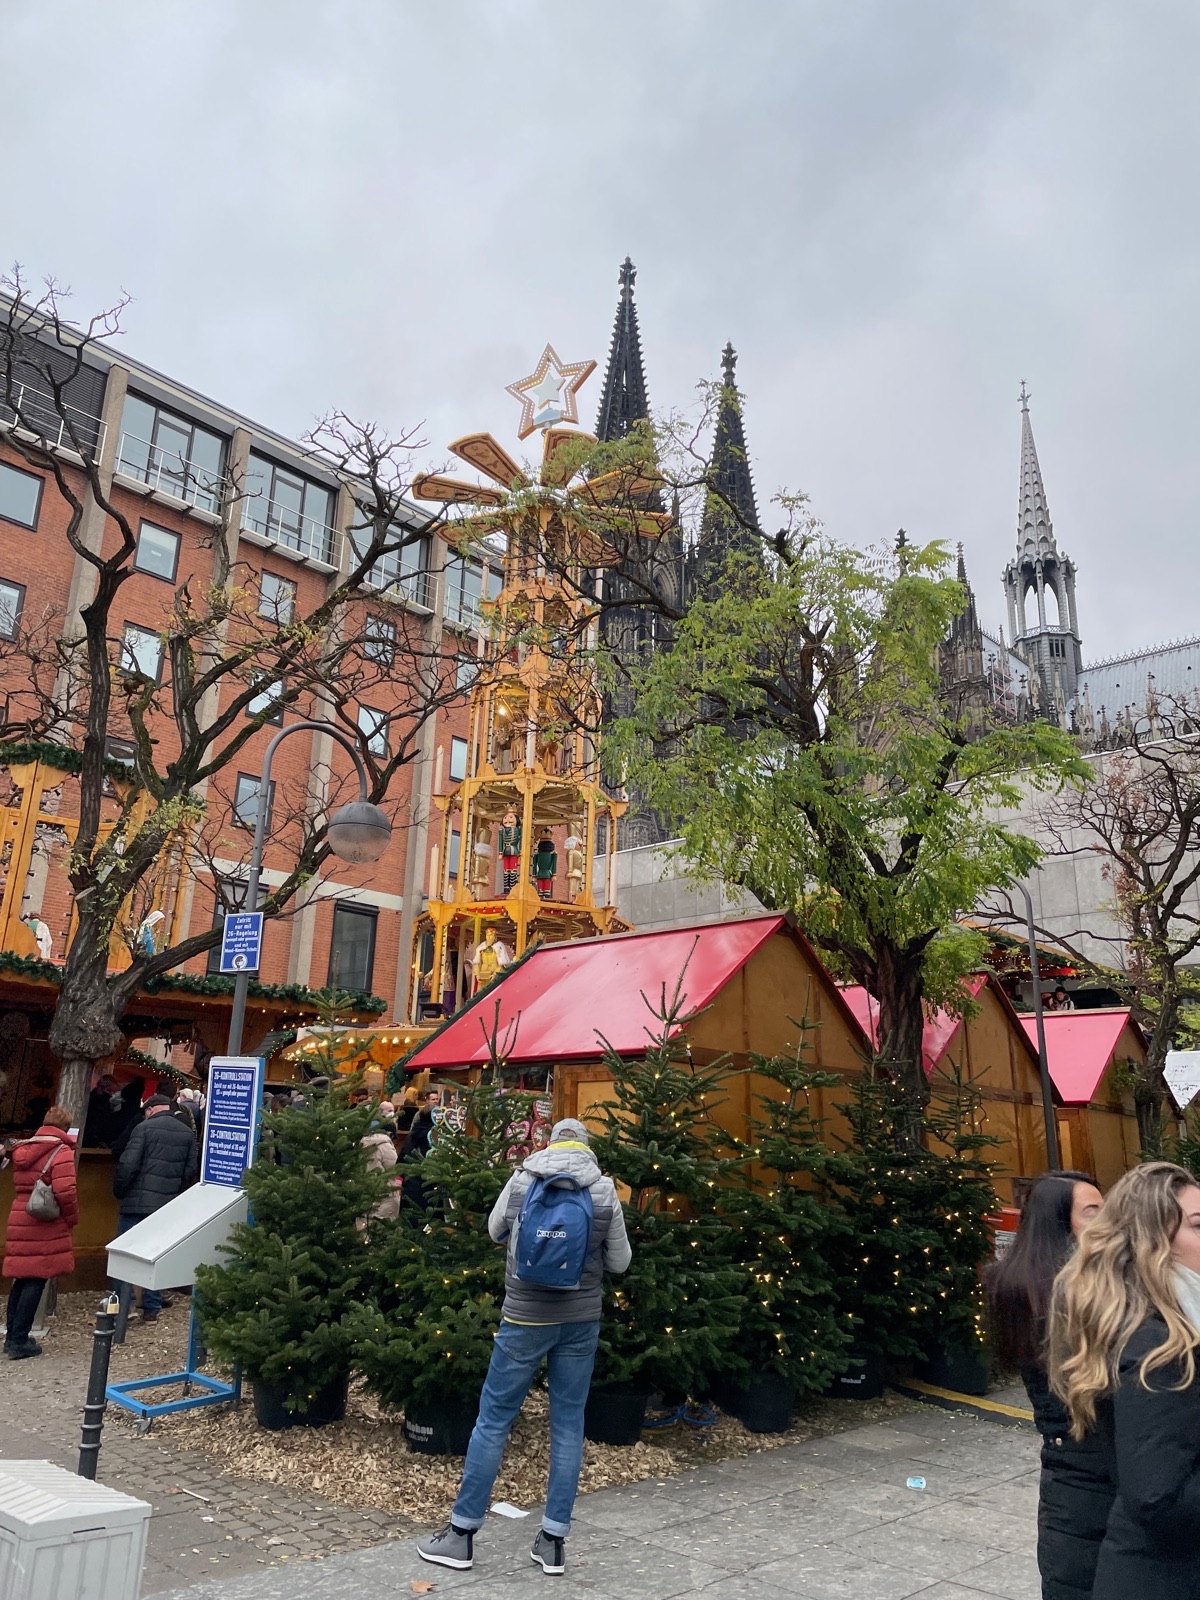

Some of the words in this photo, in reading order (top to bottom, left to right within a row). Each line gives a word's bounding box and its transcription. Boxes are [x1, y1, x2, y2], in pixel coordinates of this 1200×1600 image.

[227, 930, 258, 938] 2G-Regelung
[213, 1071, 253, 1081] 2G-KONTROLLSTATION
[210, 1129, 247, 1142] 2G-CONTROLSTATION
